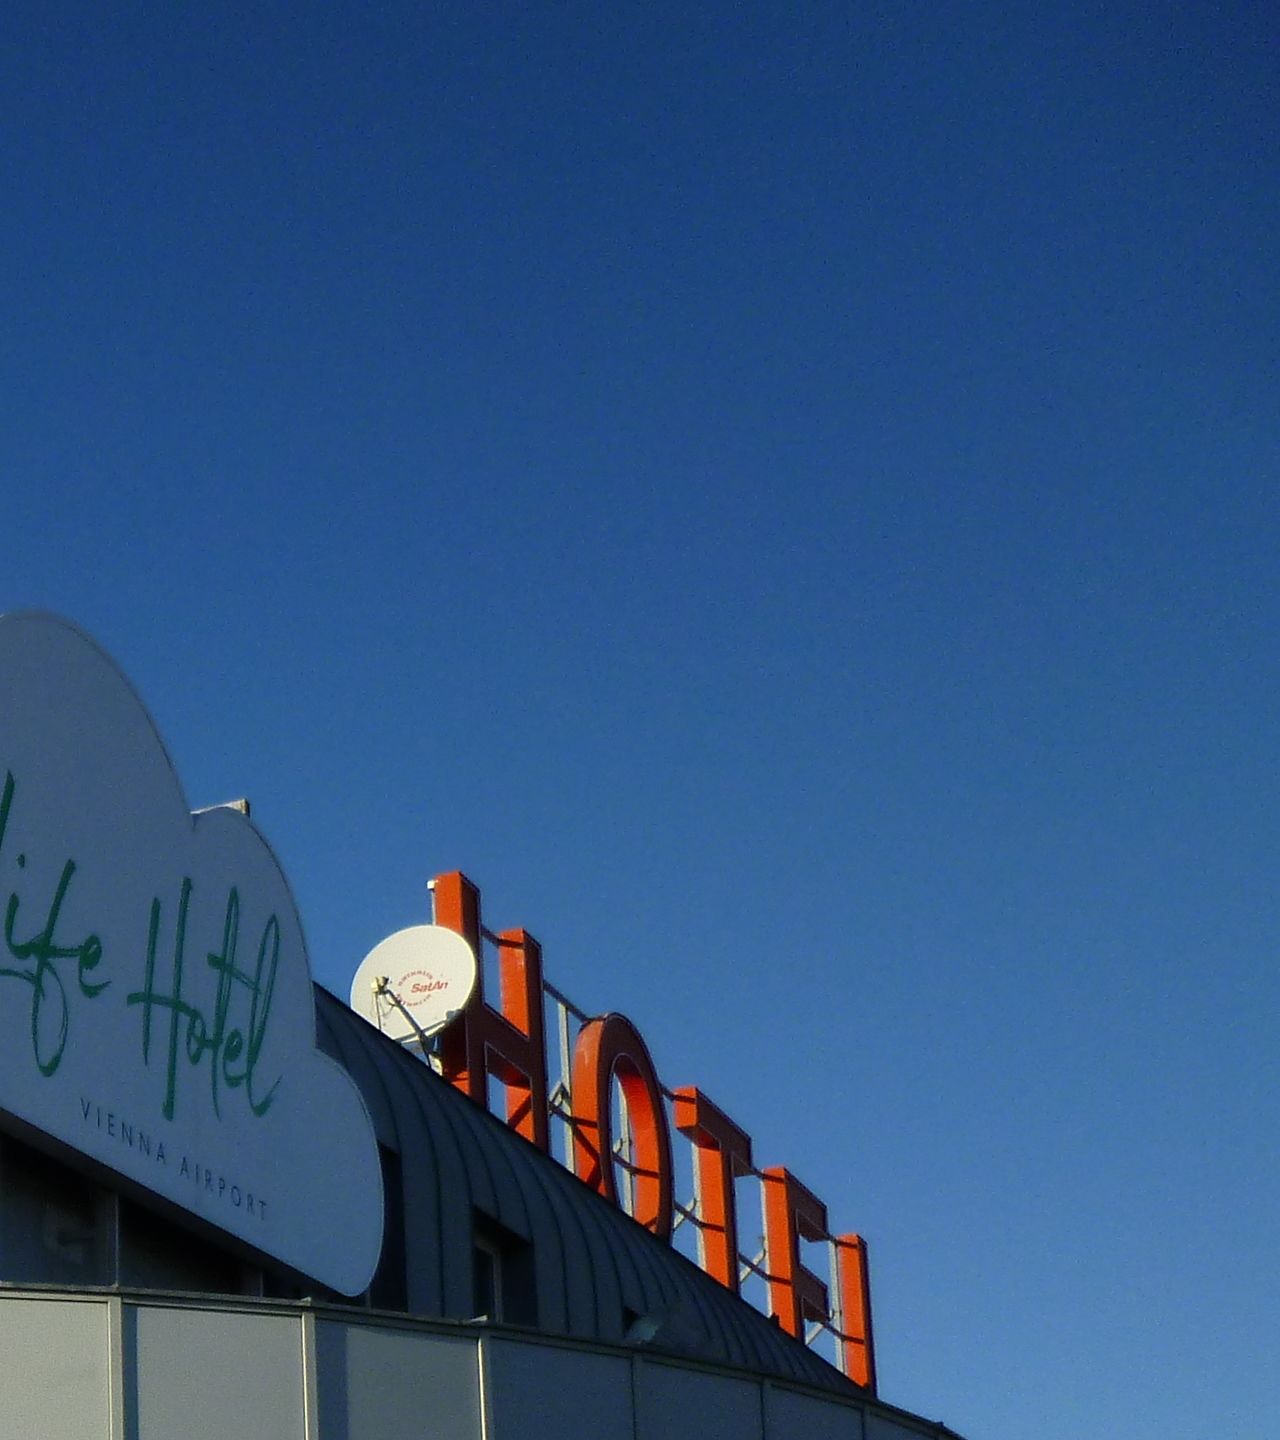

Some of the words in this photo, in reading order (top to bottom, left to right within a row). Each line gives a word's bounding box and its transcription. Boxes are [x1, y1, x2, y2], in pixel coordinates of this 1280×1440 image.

[126, 876, 284, 1122] Hotel
[80, 1097, 167, 1165] VIENNA
[179, 1156, 267, 1221] AIRPORT
